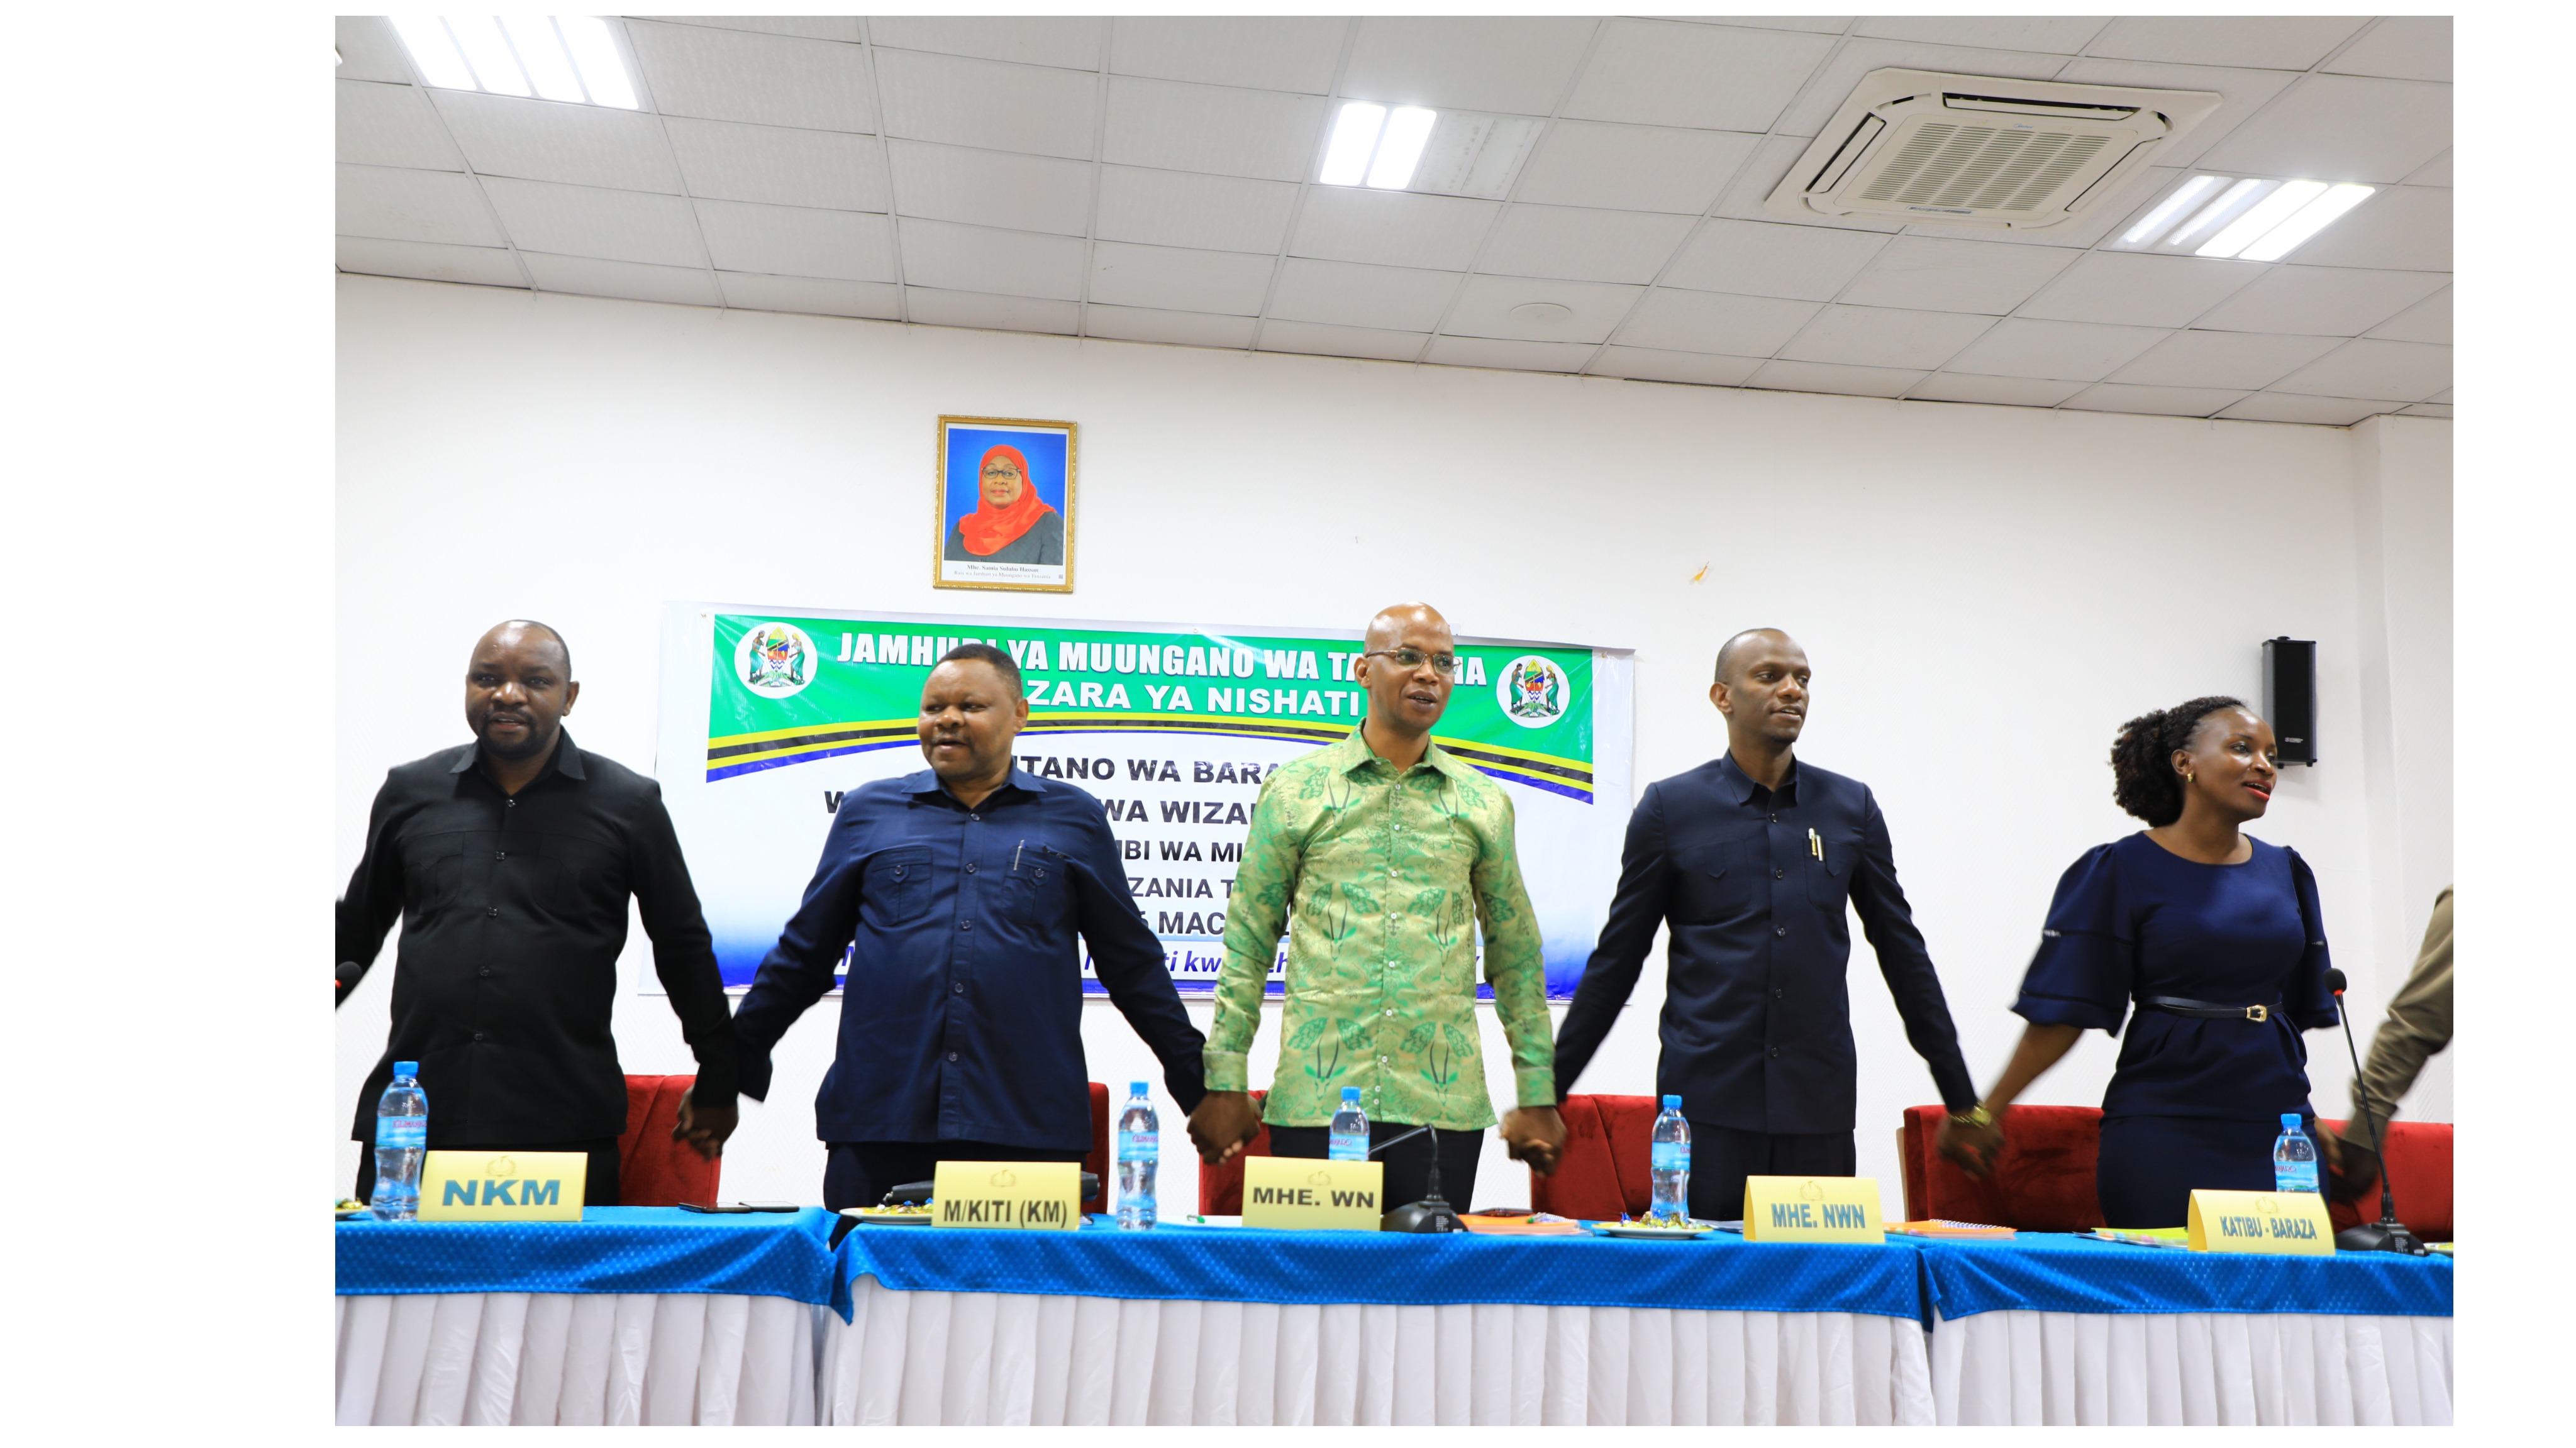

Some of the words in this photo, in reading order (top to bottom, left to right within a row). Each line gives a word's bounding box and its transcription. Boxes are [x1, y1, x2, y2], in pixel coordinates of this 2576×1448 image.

[837, 633, 997, 666] JAMHU
[1007, 639, 1049, 670] YA
[1058, 641, 1254, 678] MUUNGANO
[1263, 649, 1319, 680] WA
[1027, 680, 1131, 709] ZARA
[1145, 685, 1194, 711] YA
[1208, 687, 1359, 716] NISHATI
[1127, 759, 1181, 782] WA
[1099, 799, 1149, 822] WA
[1160, 800, 1257, 825] WIZA
[1159, 841, 1202, 861] WA
[1128, 877, 1213, 898] ZANIA
[1158, 911, 1224, 934] MAC
[442, 1180, 561, 1206] NKM
[1253, 1187, 1321, 1206] MHE.
[1331, 1190, 1374, 1208] WN
[943, 1200, 1011, 1222] M/KITI
[1019, 1200, 1067, 1228] (KM)
[1771, 1203, 1818, 1228] MHE.
[1821, 1203, 1866, 1229] NWN
[2219, 1216, 2263, 1238] KATIBU
[2270, 1217, 2318, 1240] BARAZA
